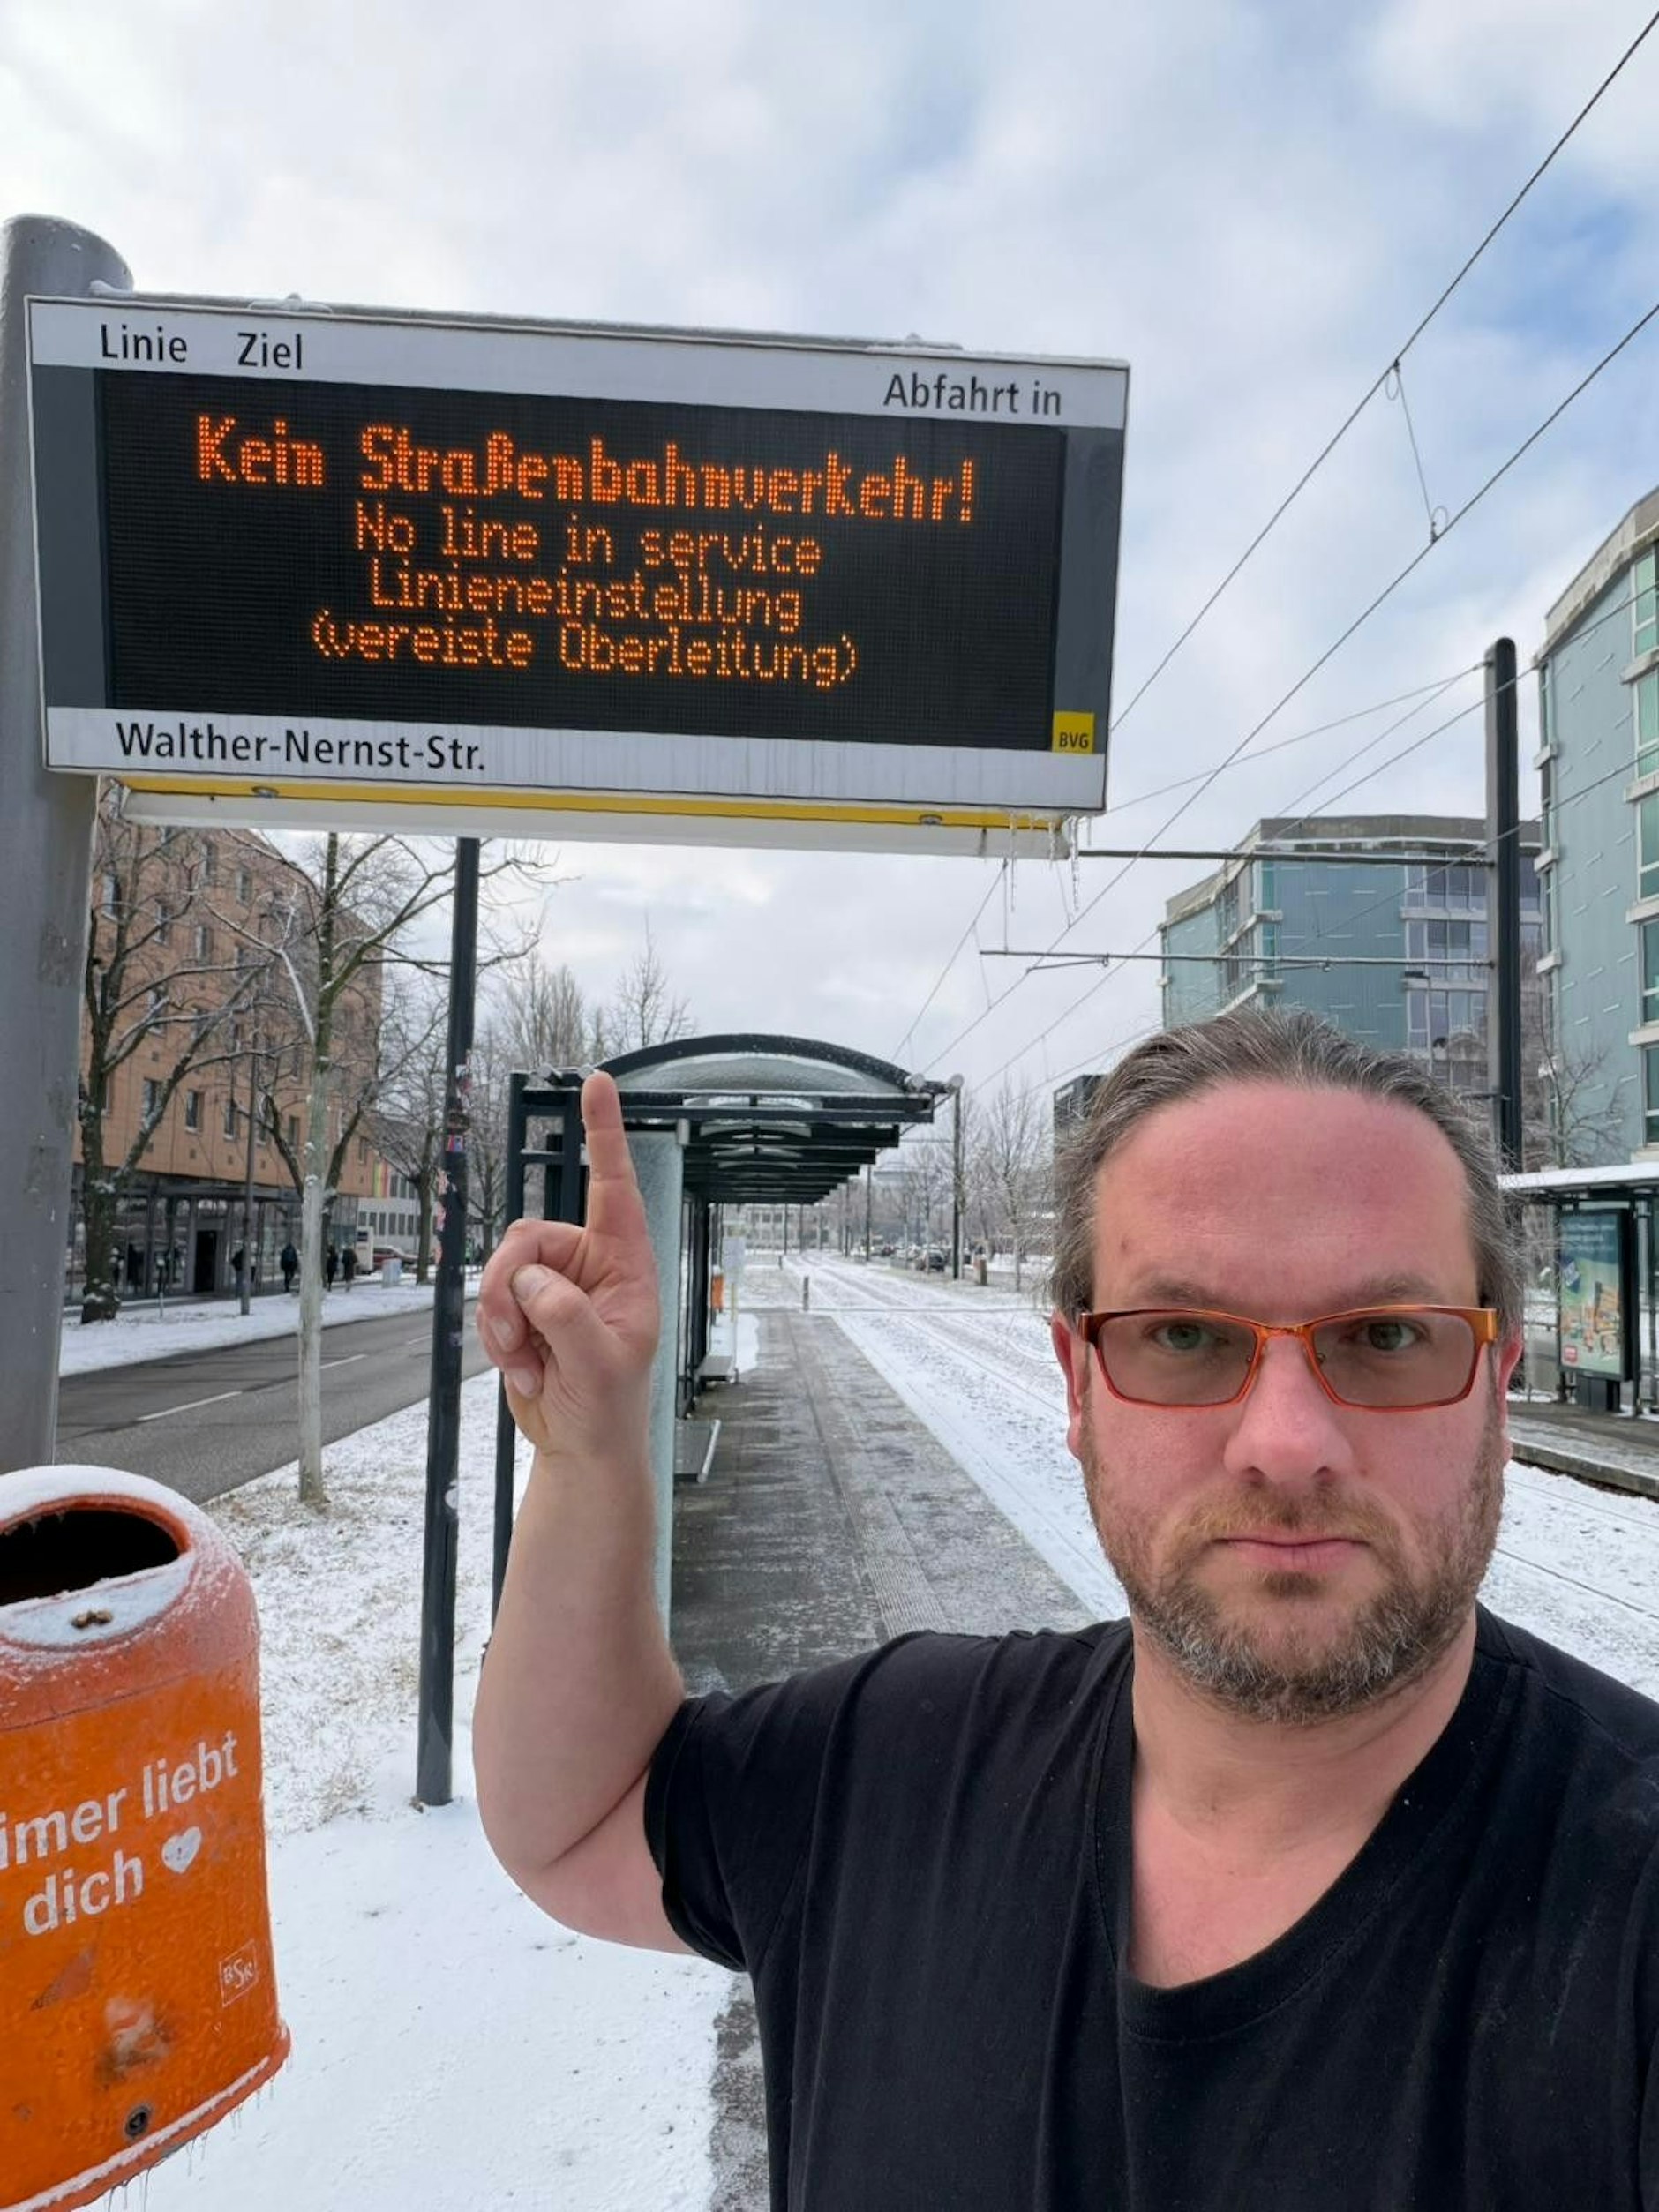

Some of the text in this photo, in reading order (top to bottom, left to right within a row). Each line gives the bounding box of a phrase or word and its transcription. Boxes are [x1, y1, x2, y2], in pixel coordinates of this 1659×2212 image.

[101, 324, 302, 370] Linie Ziel
[883, 372, 1062, 416] Abfahrt in
[198, 416, 974, 522] Kein Straßenbahnverkehr!
[356, 500, 822, 575] No line in service
[371, 558, 800, 634] Linieneinstellung
[312, 609, 856, 687] (vereiste Oberleitung)
[116, 722, 485, 770] Walther-Nernst-Str.
[1059, 731, 1090, 749] BVG
[143, 1729, 238, 1818] liebt
[23, 1849, 144, 1936] dich
